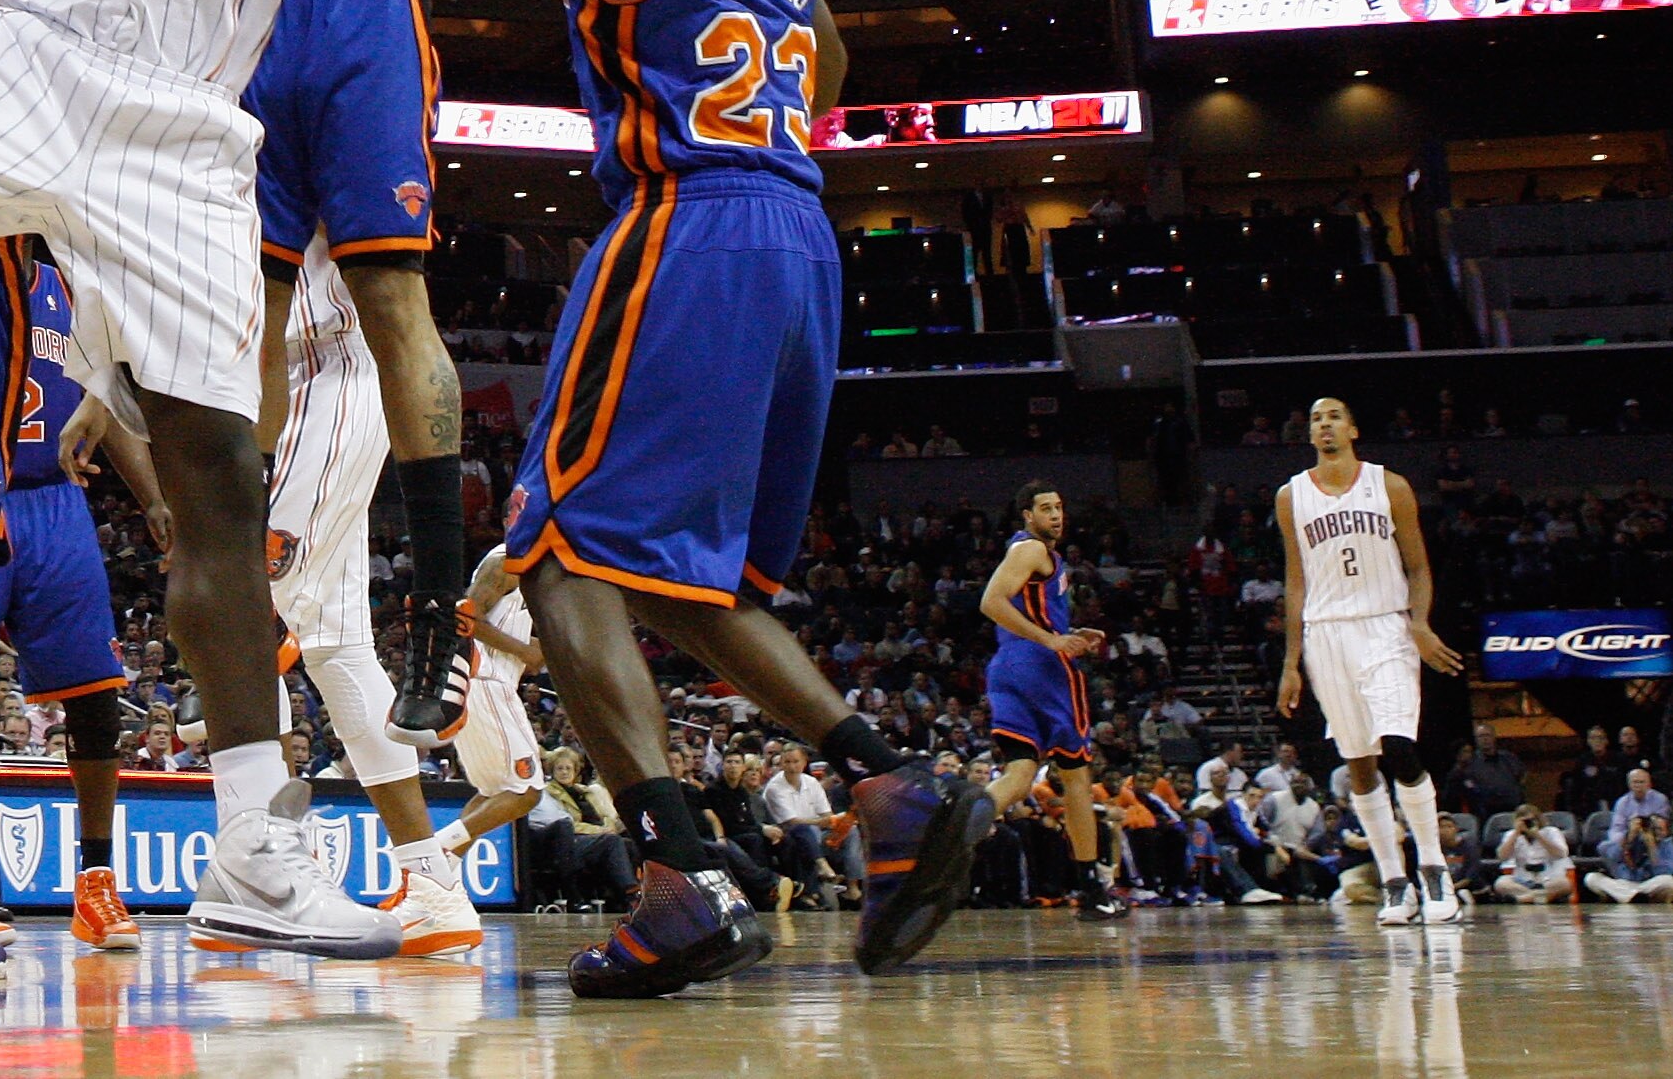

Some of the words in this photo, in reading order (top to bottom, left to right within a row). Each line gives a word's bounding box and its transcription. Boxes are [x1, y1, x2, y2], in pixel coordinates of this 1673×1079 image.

[688, 10, 818, 157] 23
[964, 100, 1040, 134] NBA
[17, 377, 45, 443] 2
[1303, 510, 1389, 550] BOBCATS
[1341, 547, 1359, 577] 2
[1483, 635, 1558, 653] BUD
[1571, 634, 1671, 651] LIGHT
[356, 812, 500, 897] Be
